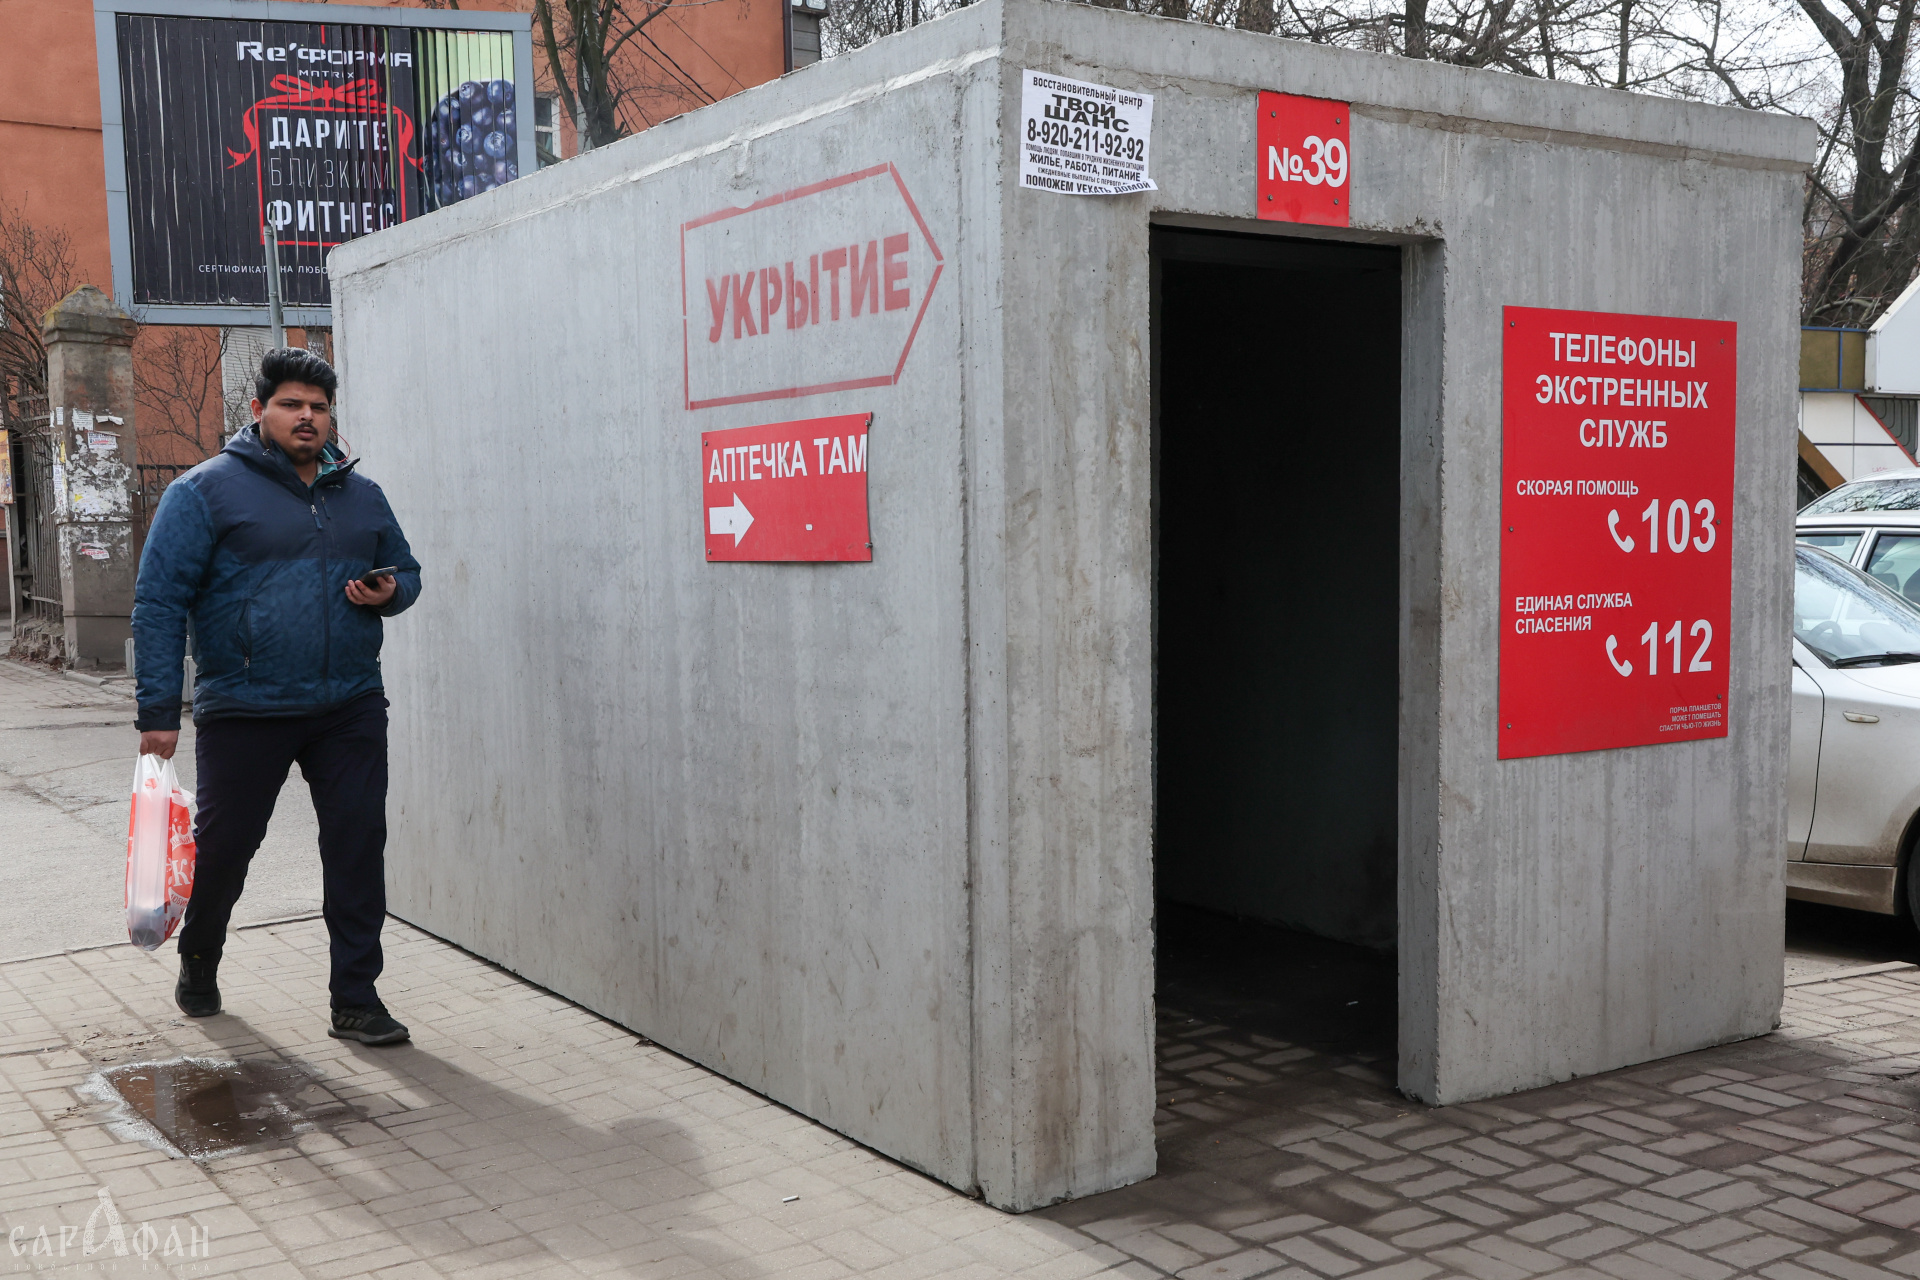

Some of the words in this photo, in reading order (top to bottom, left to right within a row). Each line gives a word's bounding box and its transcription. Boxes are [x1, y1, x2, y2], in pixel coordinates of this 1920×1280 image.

[299, 69, 355, 79] MATRIX
[1033, 76, 1116, 102] восстановительный
[1118, 94, 1143, 110] центр
[1051, 93, 1116, 119] ТВОЙ
[269, 116, 388, 151] ДАРИТЕ
[1044, 104, 1130, 133] ШАНС
[1027, 117, 1144, 162] 8-920-211-92-92
[270, 157, 390, 190] БЛИЗКИМ
[1029, 153, 1063, 170] ЖИЛЬЕ,
[1064, 159, 1100, 176] РАБОТА,
[1102, 166, 1141, 182] ПИТАНИЕ
[1037, 166, 1071, 179] ЕЖЕДНЕВНЫЕ
[1071, 173, 1096, 184] ВЫПЛАТЫ
[1268, 135, 1348, 188] №39
[1025, 174, 1074, 192] ПОМОЖЕМ
[1076, 182, 1112, 194] УЕХАТЬ
[1113, 180, 1152, 194] ДОМОЙ
[266, 199, 394, 233] ФИТНЕС
[280, 264, 294, 273] НА
[297, 264, 328, 275] ЛЮБО
[705, 231, 911, 344] УКРЫТИЕ
[1549, 331, 1697, 368] ТЕЛЕФОНЫ
[1535, 374, 1709, 409] ЭКСТРЕННЫХ
[1579, 418, 1668, 449] СЛУЖБ
[708, 440, 808, 484] АПТЕЧКА
[813, 434, 868, 475] ТАМ
[1516, 479, 1573, 497] СКОРАЯ
[1576, 480, 1639, 499] ПОМОЩЬ
[1641, 498, 1717, 554] 103
[1515, 594, 1574, 613] ЕДИНАЯ
[1576, 592, 1633, 610] СЛУЖБА
[1515, 615, 1592, 635] СПАСЕНИЯ
[1641, 618, 1713, 676] 112
[1669, 705, 1688, 714] ПОРЧА
[1688, 703, 1722, 712] ПЛАНШЕТОВ
[1671, 714, 1691, 722] МОЖЕТ
[1691, 711, 1722, 720] ПОМЕШАТЬ
[1659, 723, 1681, 732] СПАСТИ
[1681, 721, 1703, 730] ЧЬЮ-ТО
[1702, 719, 1722, 728] ЖИЗНЬ
